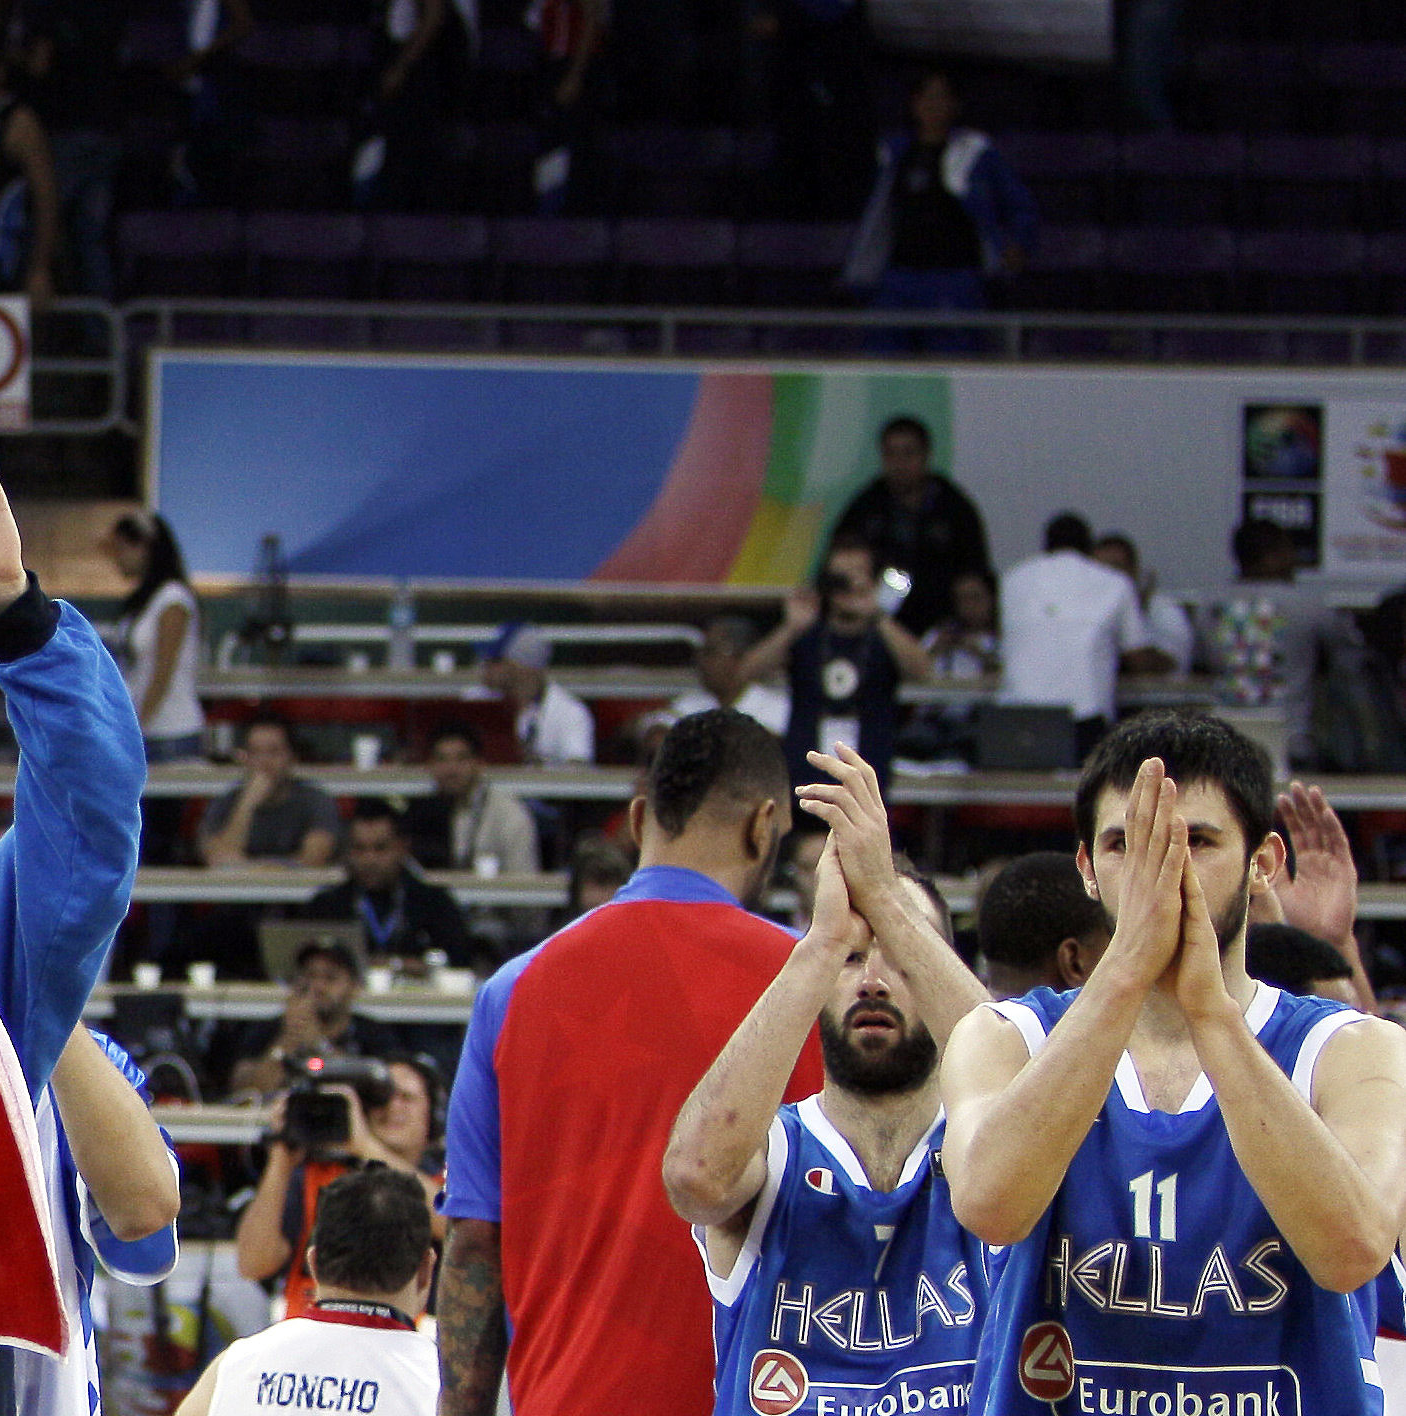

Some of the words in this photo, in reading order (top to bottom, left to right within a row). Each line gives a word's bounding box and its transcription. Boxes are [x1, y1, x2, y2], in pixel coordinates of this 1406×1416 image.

[1128, 1169, 1179, 1243] 11
[768, 1258, 978, 1354] HELLAS
[1043, 1232, 1290, 1319] HELLAS
[257, 1371, 380, 1414] MONCHO
